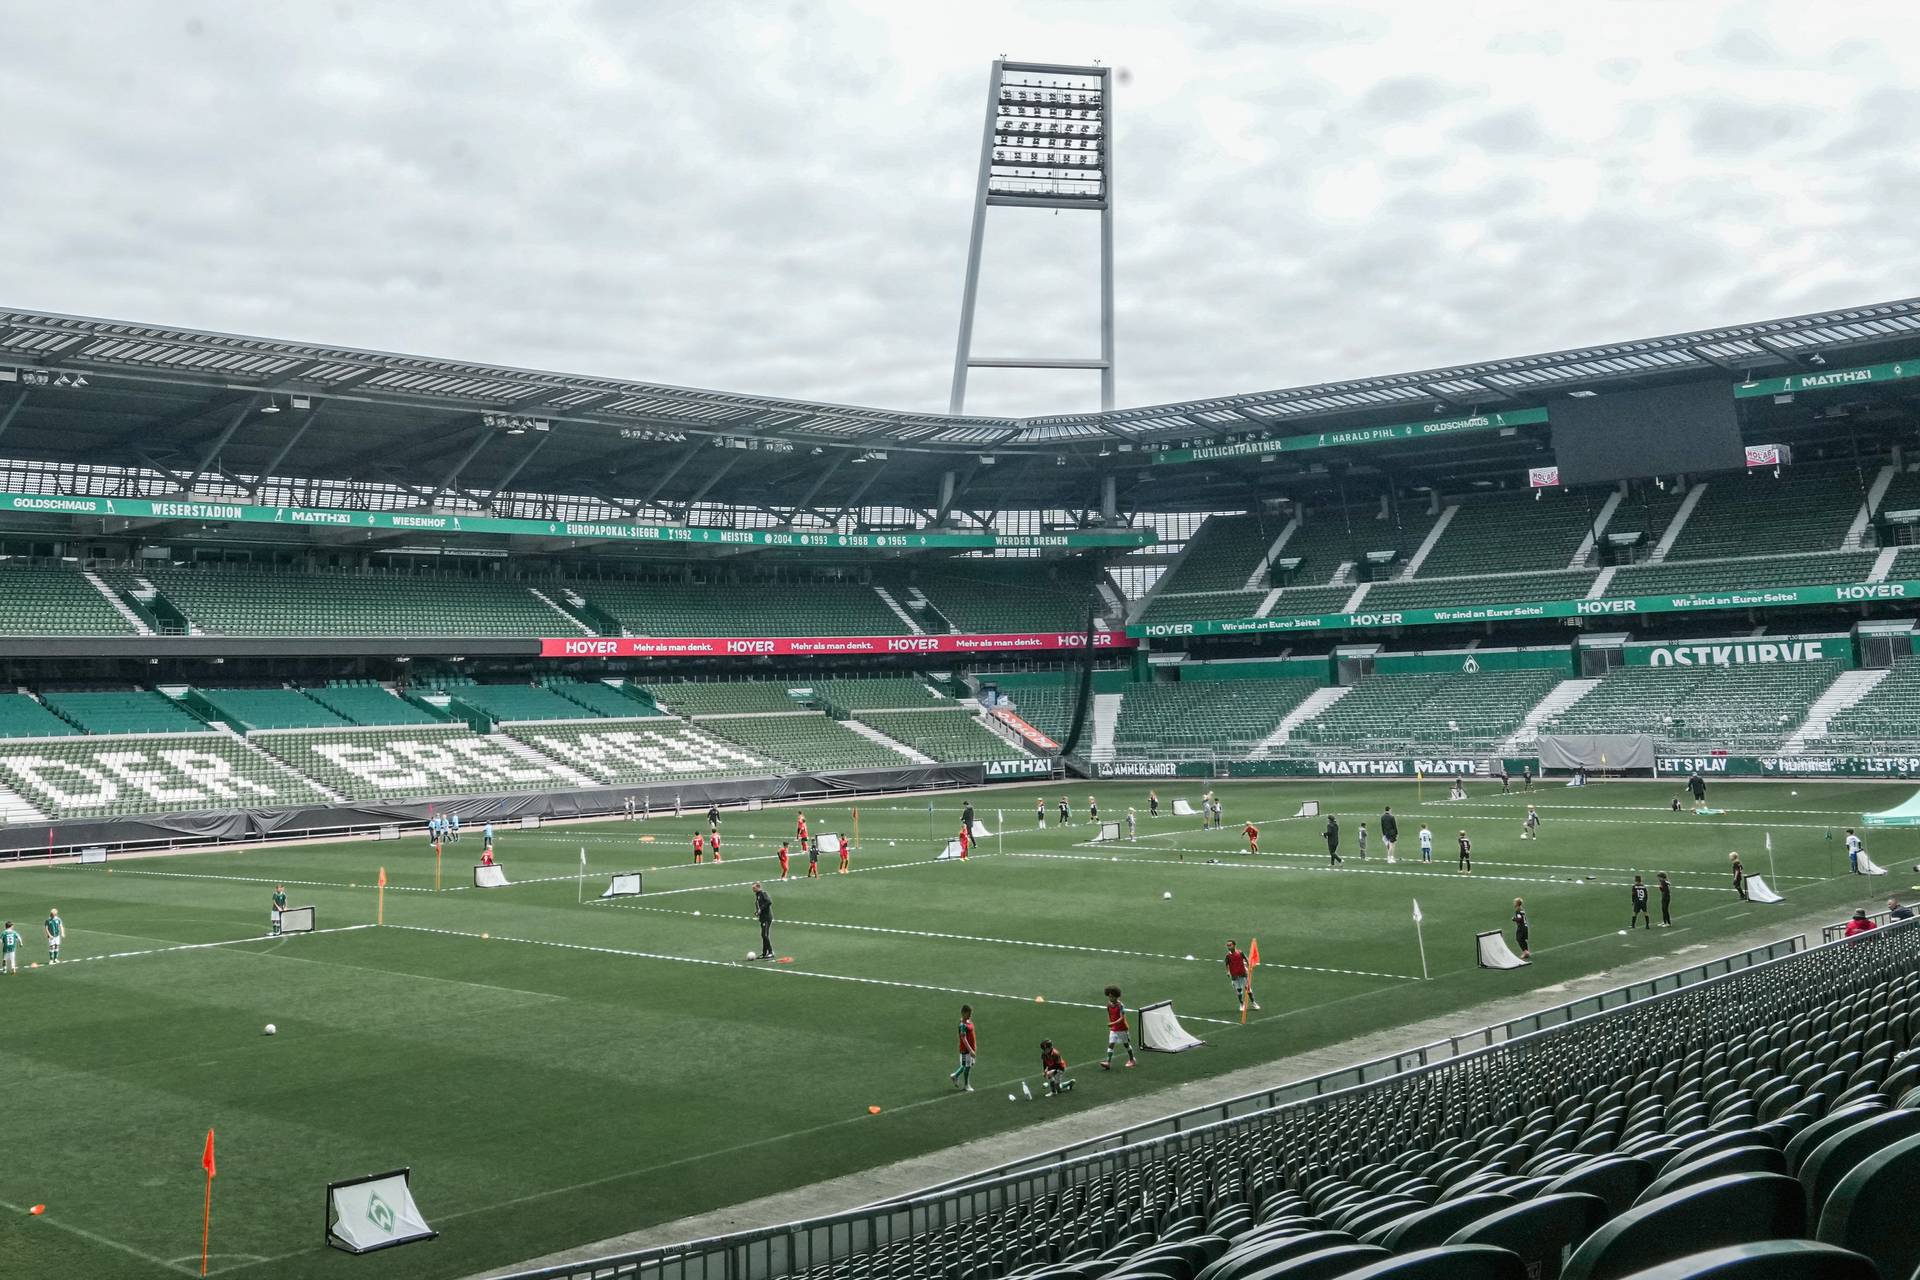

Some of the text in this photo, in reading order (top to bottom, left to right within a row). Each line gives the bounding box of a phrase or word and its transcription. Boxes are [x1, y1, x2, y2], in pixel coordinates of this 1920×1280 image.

[1802, 370, 1872, 387] MATTHÄI
[1423, 417, 1489, 433] GOLDSCHMAUS
[1332, 428, 1396, 444] HARALD PIHL
[1192, 440, 1282, 460] FLUTLICHTPARTNER
[13, 497, 97, 512] GOLDSCHMAUS
[151, 502, 242, 519] WESERSTADION
[291, 510, 351, 524] MATTHÄI
[392, 515, 446, 528] WIESENHOF
[566, 523, 692, 540] EUROPAPOKAL-SIEGER 1992
[720, 531, 754, 543] MEISTER
[772, 534, 792, 545] 2004
[810, 535, 828, 545] 1993
[848, 536, 869, 546] 1988
[995, 536, 1068, 546] WERDER BREMEN
[1836, 584, 1905, 600] HOYER
[1577, 600, 1636, 613] HOYER
[1672, 598, 1691, 608] Wir
[1692, 597, 1715, 607] sind
[1732, 595, 1763, 604] Eurer
[1764, 593, 1797, 602] Seite!
[1350, 613, 1402, 626] HOYER
[1434, 612, 1451, 620] Wir
[1452, 610, 1472, 619] sind
[1487, 608, 1513, 617] Eurer
[1514, 607, 1544, 616] Seite!
[1146, 623, 1193, 636] HOYER
[1221, 622, 1237, 631] Wir
[1238, 621, 1256, 630] sind
[1269, 620, 1293, 629] Eurer
[1294, 618, 1321, 627] Seite!
[633, 643, 656, 652] Mehr
[656, 643, 668, 652] als
[687, 642, 713, 652] denkt.
[727, 640, 774, 653] HOYER
[791, 641, 812, 650] Mehr
[813, 641, 825, 650] als
[846, 641, 873, 650] denkt.
[888, 638, 939, 651] HOYER
[956, 637, 1042, 648] Mehr als man denkt.
[1058, 634, 1111, 647] HOYER
[566, 641, 617, 654] HOYER
[1650, 641, 1823, 668] OSTKURVE
[1657, 758, 1728, 772] LET'S PLAY
